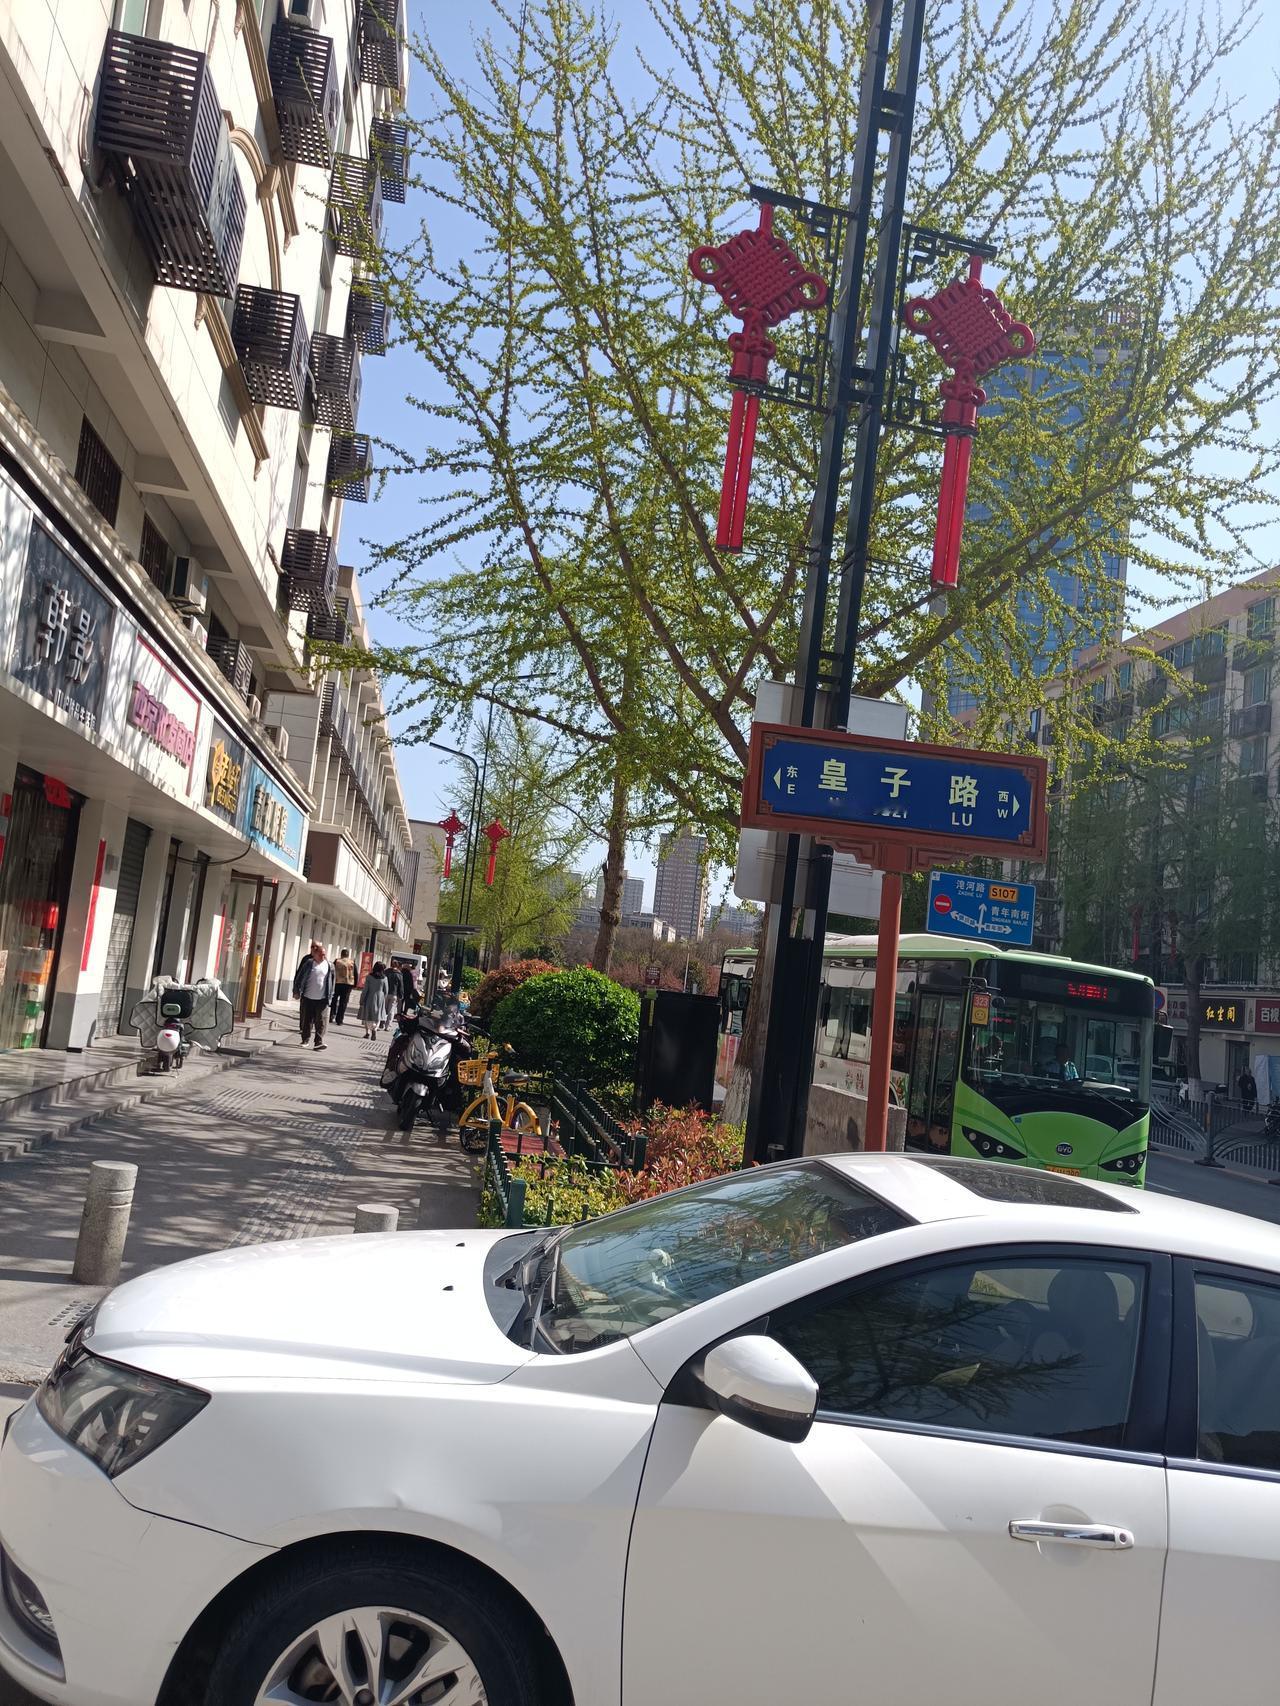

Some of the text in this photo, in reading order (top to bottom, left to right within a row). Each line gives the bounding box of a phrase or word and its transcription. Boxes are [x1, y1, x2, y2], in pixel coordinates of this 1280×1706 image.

[41, 580, 97, 686] 韩影
[786, 765, 798, 779] 东
[787, 783, 796, 795] E
[818, 758, 979, 808] 皇子路
[997, 790, 1010, 803] 西
[951, 812, 973, 827] LU
[997, 809, 1009, 819] W
[991, 887, 1016, 900] S107
[991, 906, 1030, 920] 青年南街
[973, 996, 989, 1007] 323
